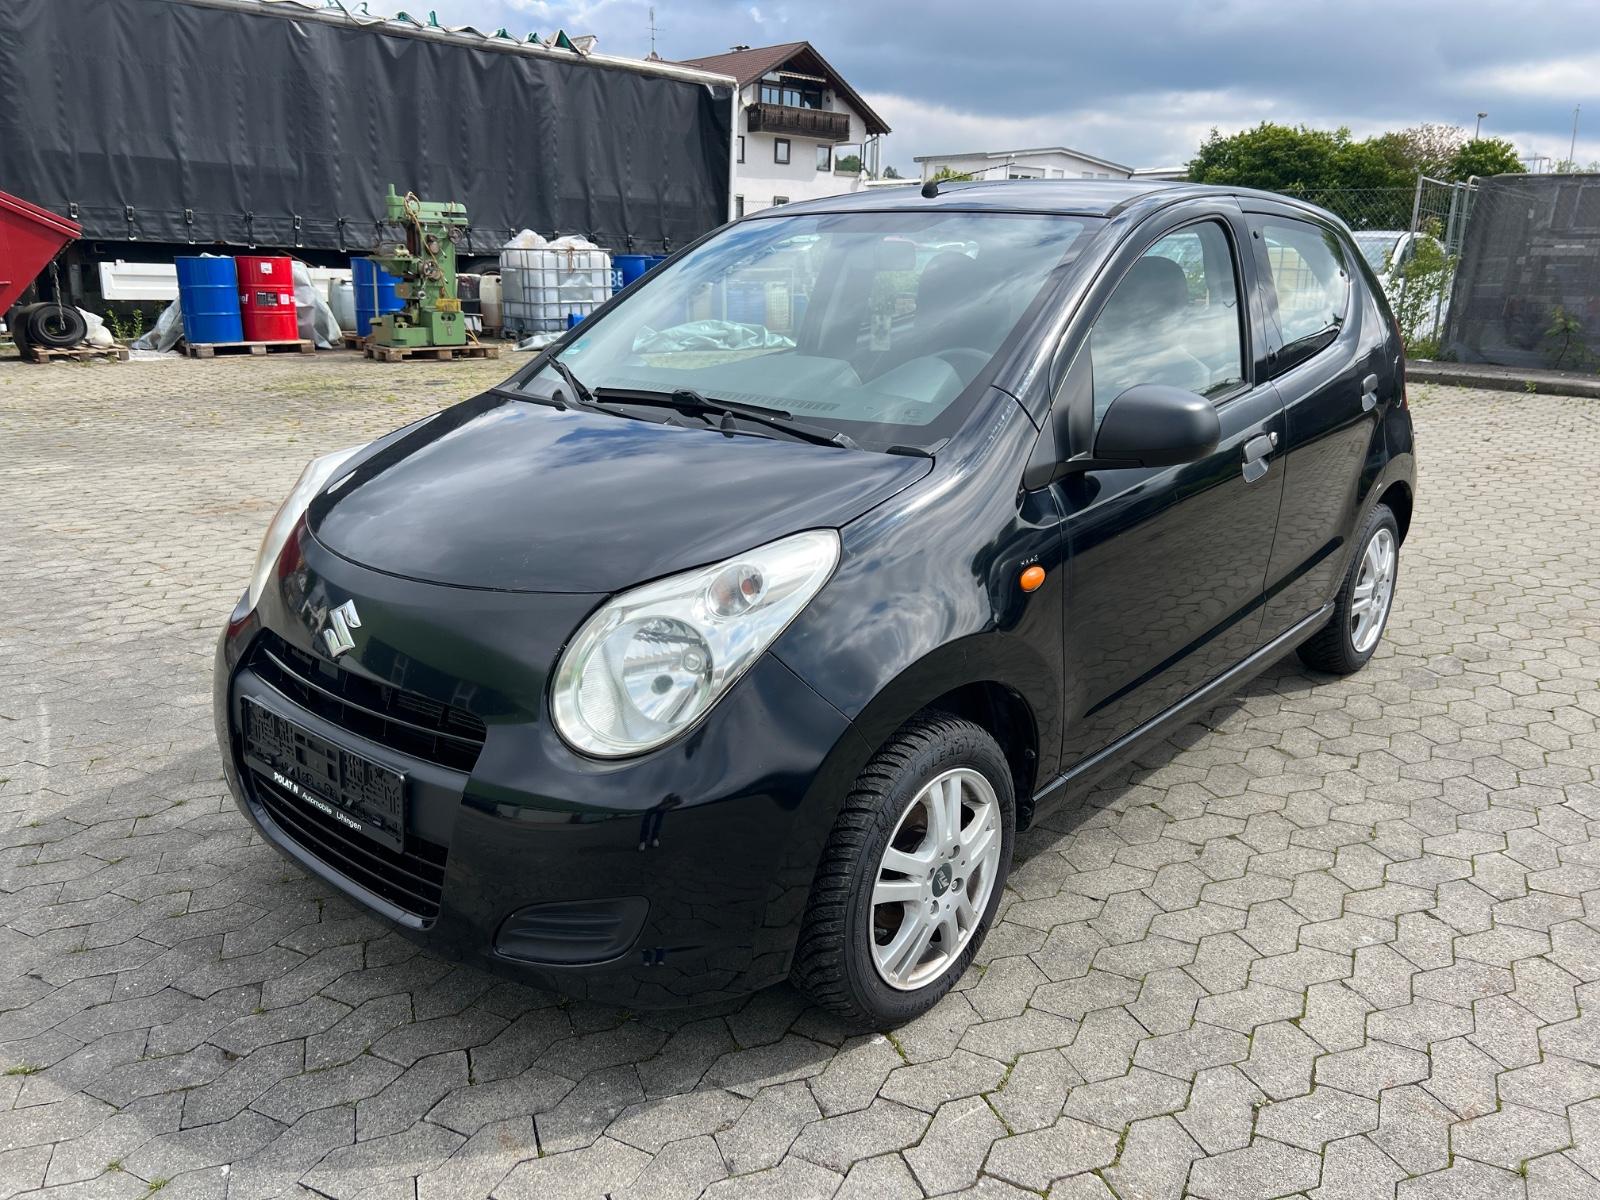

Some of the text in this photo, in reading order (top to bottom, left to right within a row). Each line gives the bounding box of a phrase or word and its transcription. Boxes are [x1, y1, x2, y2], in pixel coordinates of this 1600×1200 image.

[273, 771, 293, 790] POLAT
[301, 792, 333, 815] Automobile
[336, 811, 362, 831] Uhingen
